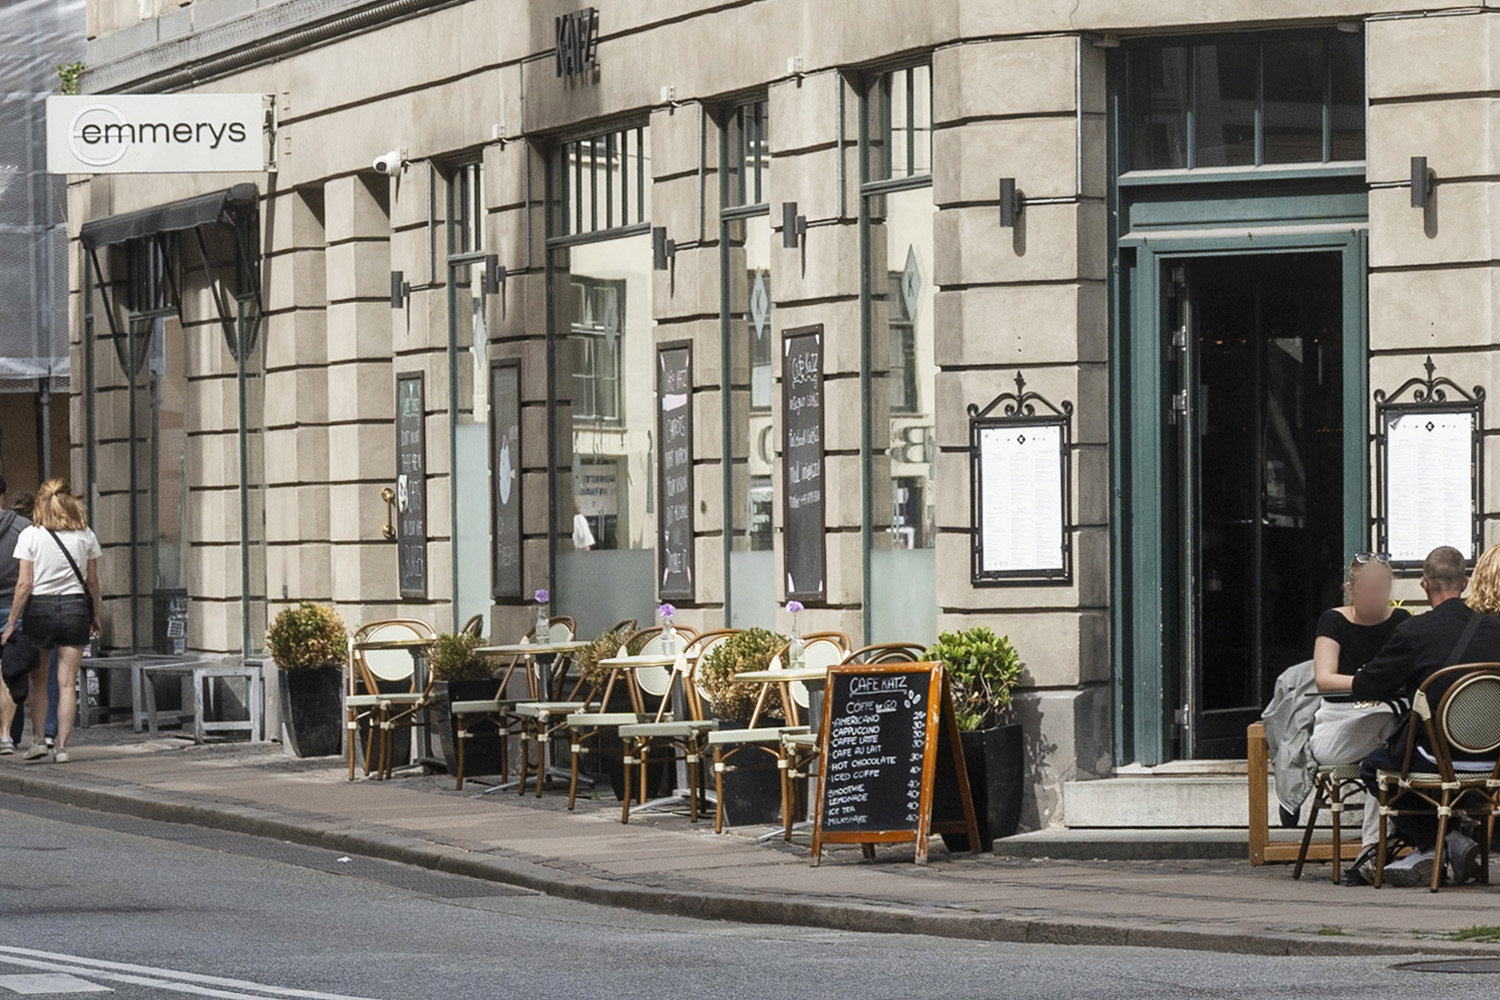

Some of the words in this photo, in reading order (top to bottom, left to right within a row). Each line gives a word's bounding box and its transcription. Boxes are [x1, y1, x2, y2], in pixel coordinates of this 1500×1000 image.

[555, 7, 597, 77] KATZ
[82, 121, 247, 149] emmerys
[881, 676, 908, 690] KATZ
[846, 701, 875, 714] COFFE
[883, 700, 898, 709] GO
[833, 714, 880, 727] AMERICANO
[832, 726, 880, 738] CAPPUCCINO
[854, 746, 865, 755] AU
[866, 745, 882, 754] LAIT
[831, 761, 849, 771] HOT
[851, 756, 897, 768] CHOCOLATE
[831, 773, 851, 783] ICED
[852, 769, 880, 779] COFFE
[827, 784, 865, 798] SMOOTHIE
[828, 793, 869, 806] LEMONADE
[828, 807, 840, 816] ICE
[842, 805, 856, 814] TEA
[827, 815, 868, 827] MILKSHAKE
